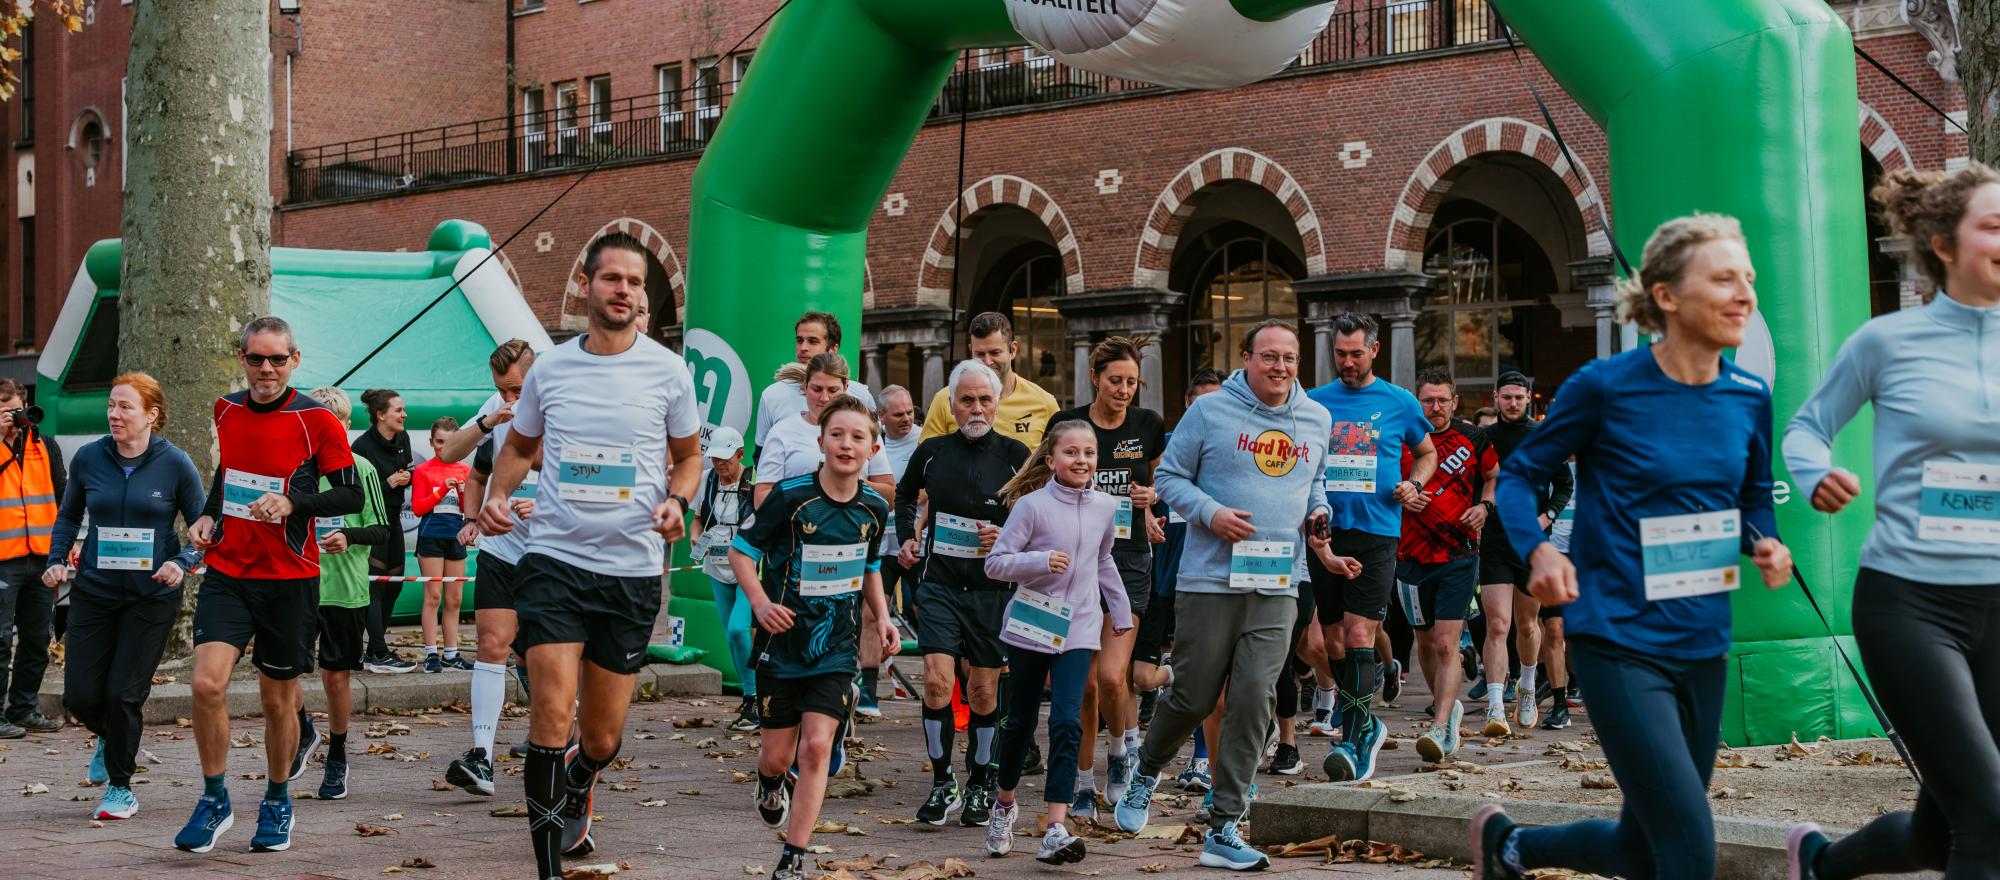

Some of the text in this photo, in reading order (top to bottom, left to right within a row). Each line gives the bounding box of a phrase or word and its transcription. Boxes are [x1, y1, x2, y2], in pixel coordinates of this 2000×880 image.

[1014, 422, 1030, 433] EY
[1237, 432, 1309, 463] Hard Rock
[1440, 446, 1471, 475] 100
[570, 465, 601, 479] STIJN
[1093, 470, 1129, 484] IGHT
[1330, 468, 1369, 478] MAARTEN
